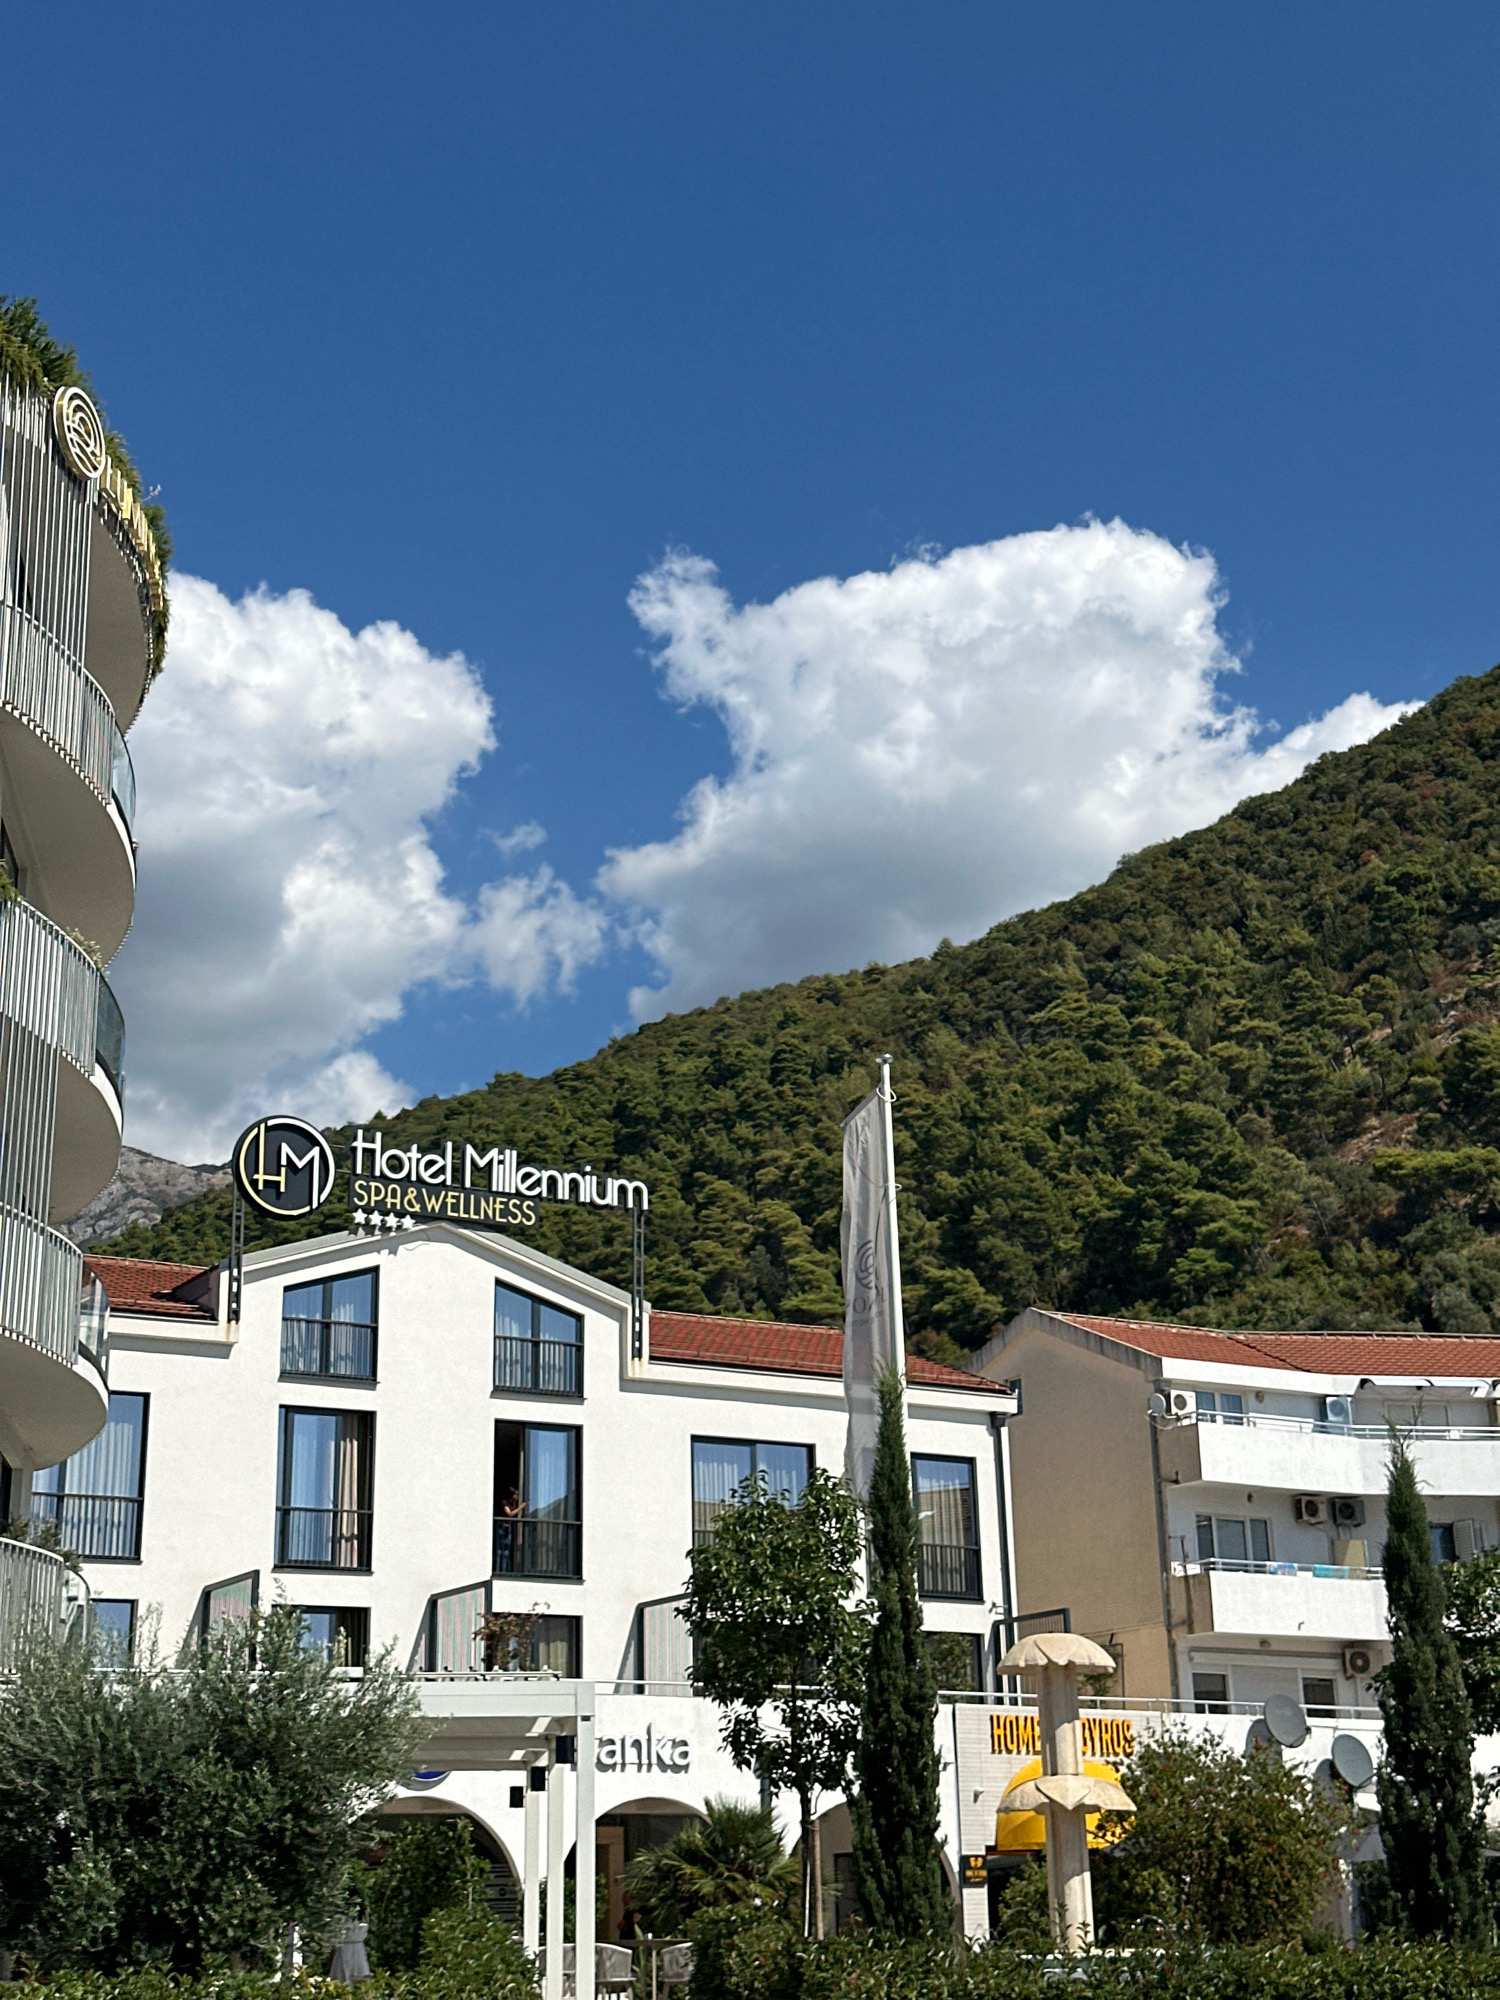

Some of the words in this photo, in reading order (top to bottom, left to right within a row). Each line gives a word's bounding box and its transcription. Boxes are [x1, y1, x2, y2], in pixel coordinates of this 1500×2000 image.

[351, 1128, 453, 1186] Hotel
[464, 1143, 649, 1211] Millennium
[353, 1179, 537, 1226] SPA&WELLNESS
[594, 1721, 691, 1770] anka
[990, 1714, 1042, 1754] HOME
